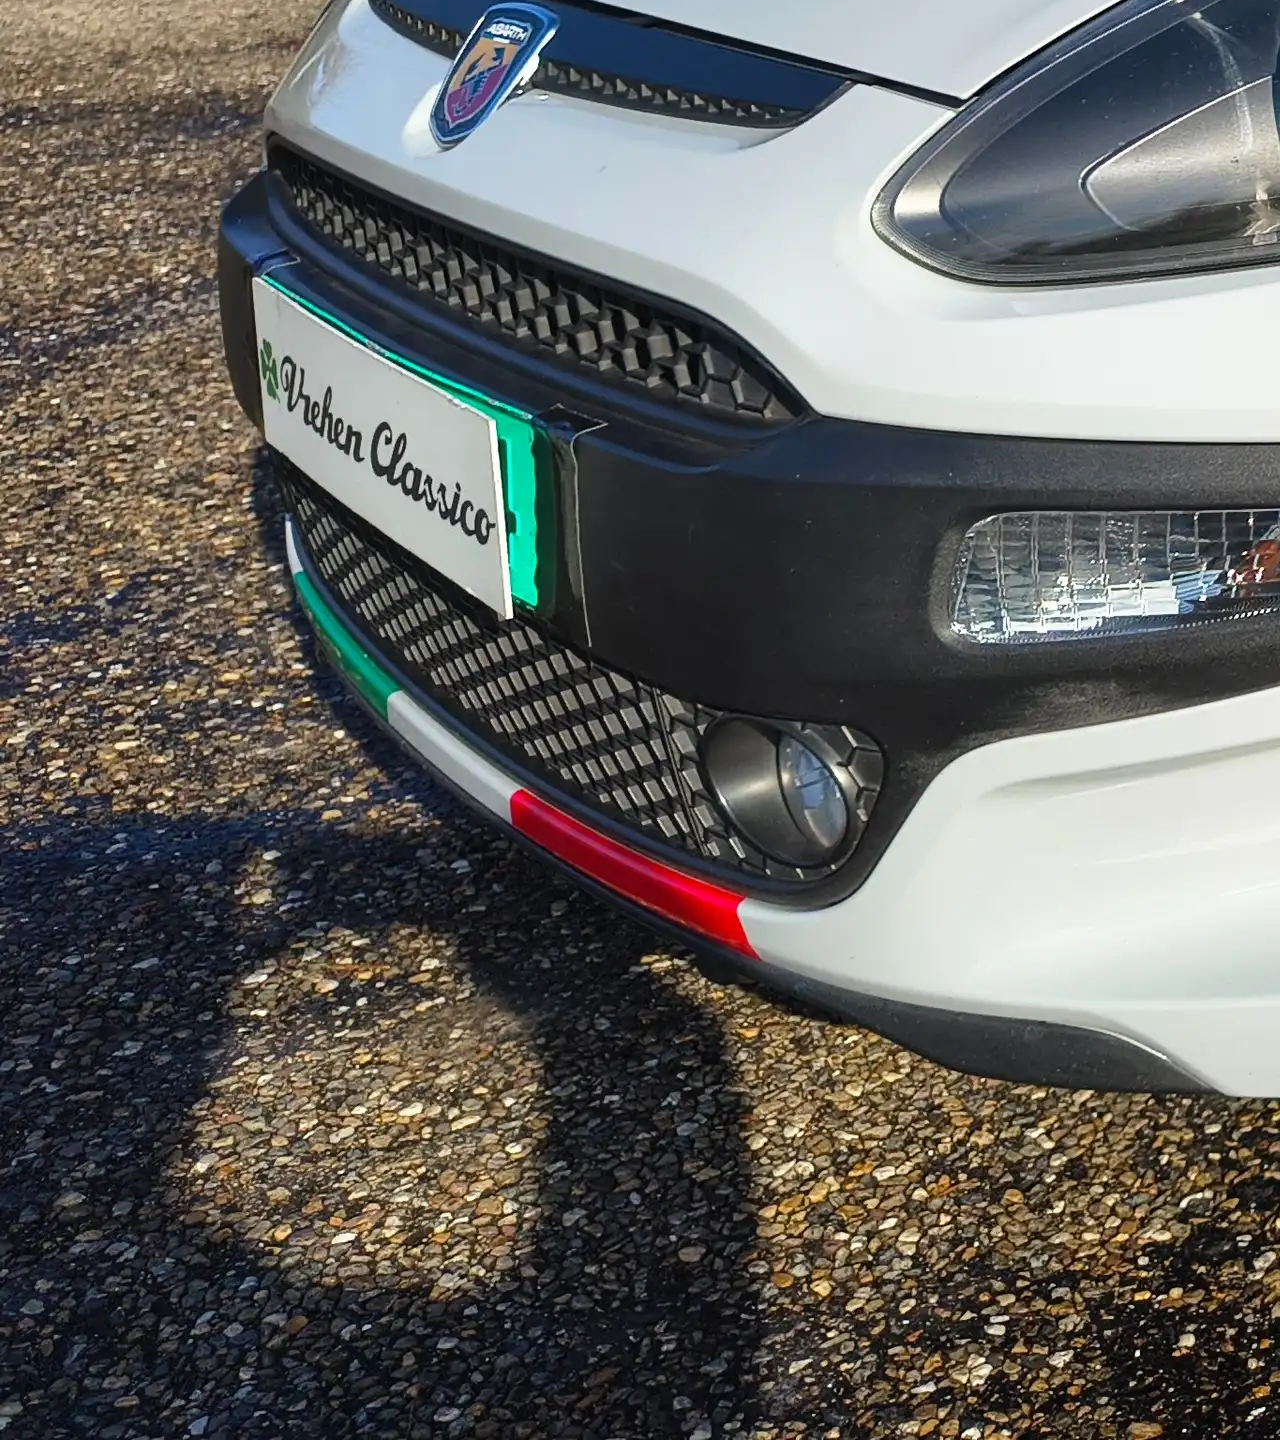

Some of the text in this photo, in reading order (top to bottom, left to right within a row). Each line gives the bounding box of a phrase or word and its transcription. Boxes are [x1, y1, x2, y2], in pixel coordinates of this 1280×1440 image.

[486, 23, 528, 41] ABARTH
[280, 355, 497, 546] Vrehen Classico
